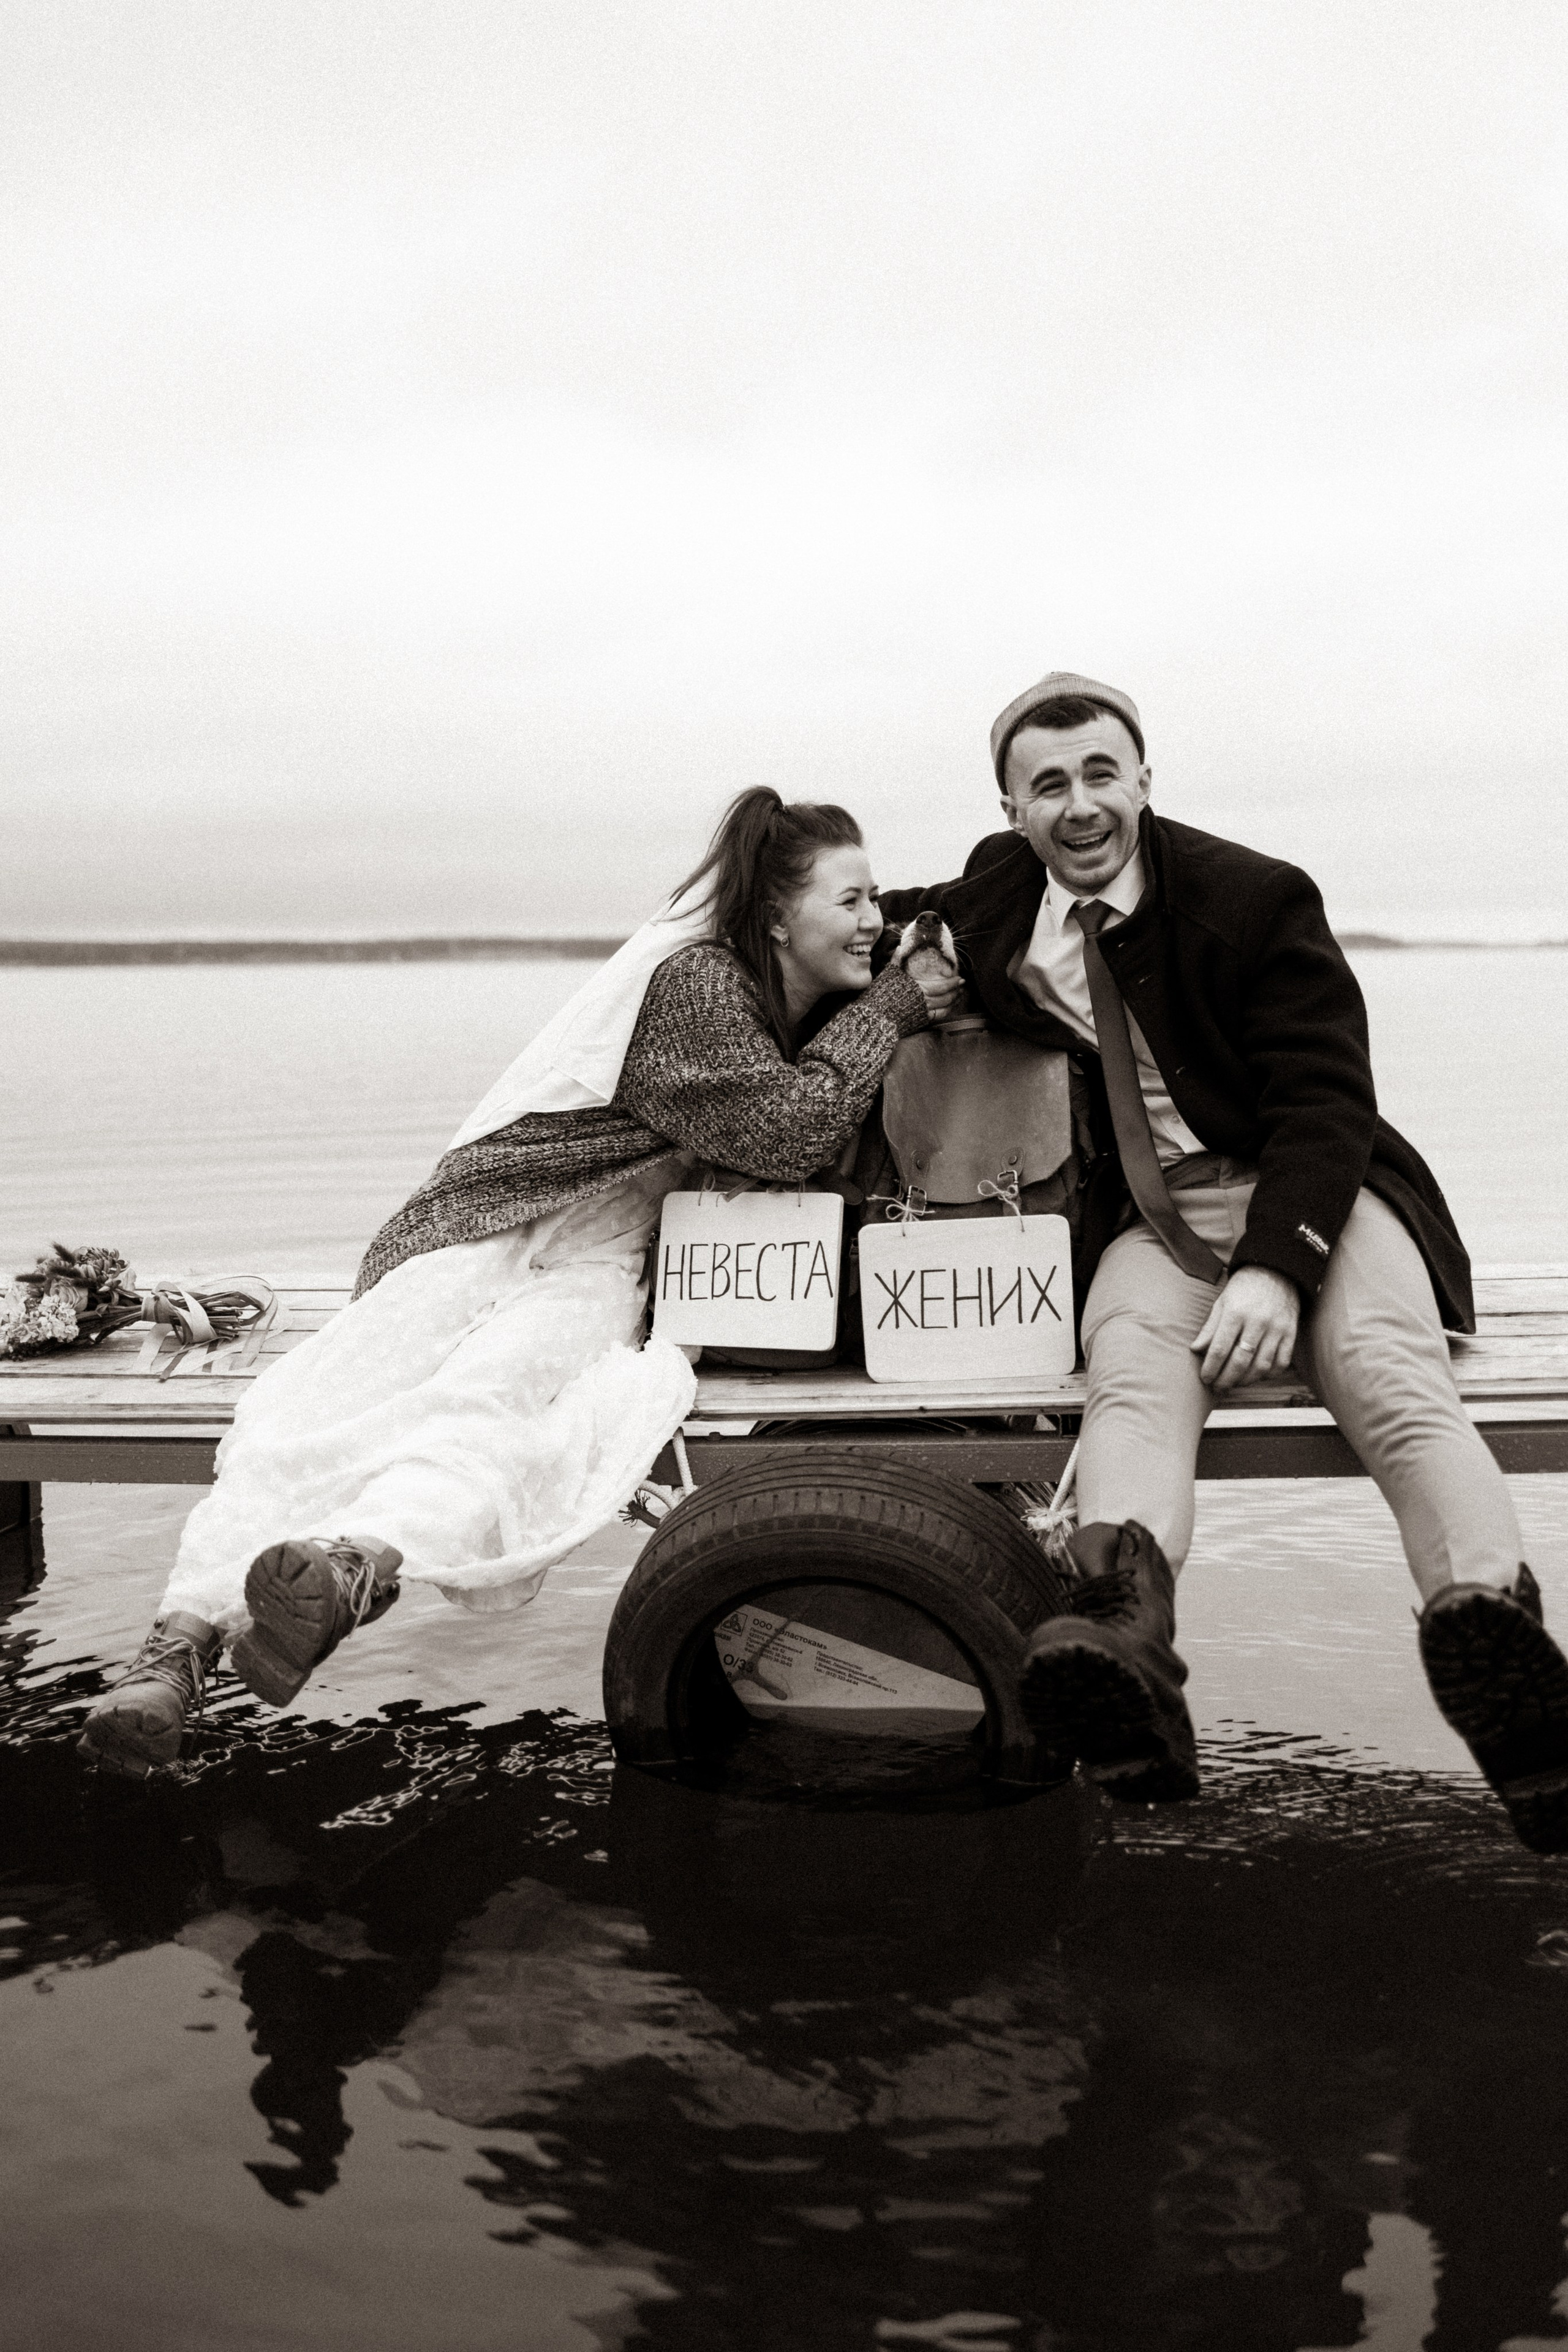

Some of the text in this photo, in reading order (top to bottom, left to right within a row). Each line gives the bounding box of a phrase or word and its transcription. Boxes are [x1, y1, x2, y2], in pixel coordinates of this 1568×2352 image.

[663, 1240, 834, 1302] НЕВЕСТА
[874, 1265, 1063, 1330] ЖЕНИХ
[753, 1618, 772, 1630] ООО
